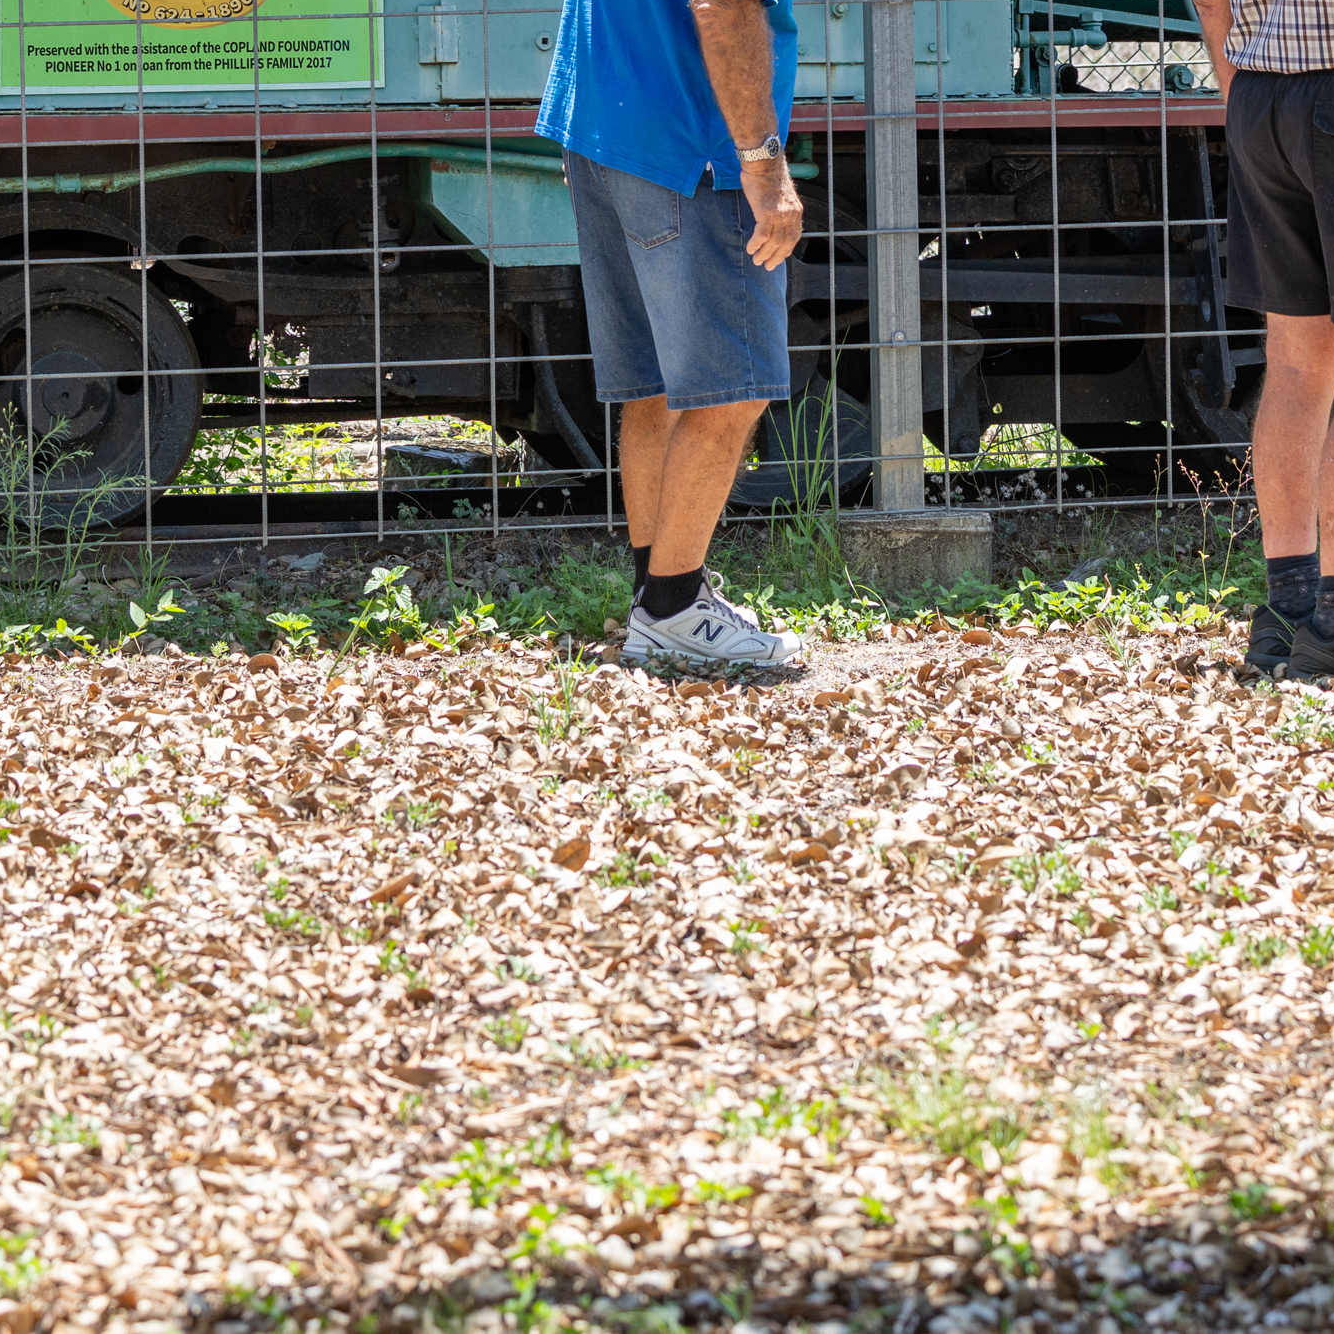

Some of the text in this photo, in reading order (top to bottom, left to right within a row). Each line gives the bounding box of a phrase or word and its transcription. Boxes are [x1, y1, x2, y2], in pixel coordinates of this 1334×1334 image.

[154, 6, 192, 23] 624
[28, 44, 82, 56] Preserved
[85, 43, 109, 55] with
[112, 43, 129, 55] the
[132, 42, 187, 55] assistance
[190, 41, 201, 53] of
[203, 41, 220, 53] the
[278, 40, 350, 52] FOUNDATION
[46, 57, 332, 72] PIONEER No 1 on oan from the PHILLIPS FAMILY 2017
[689, 616, 727, 644] N
